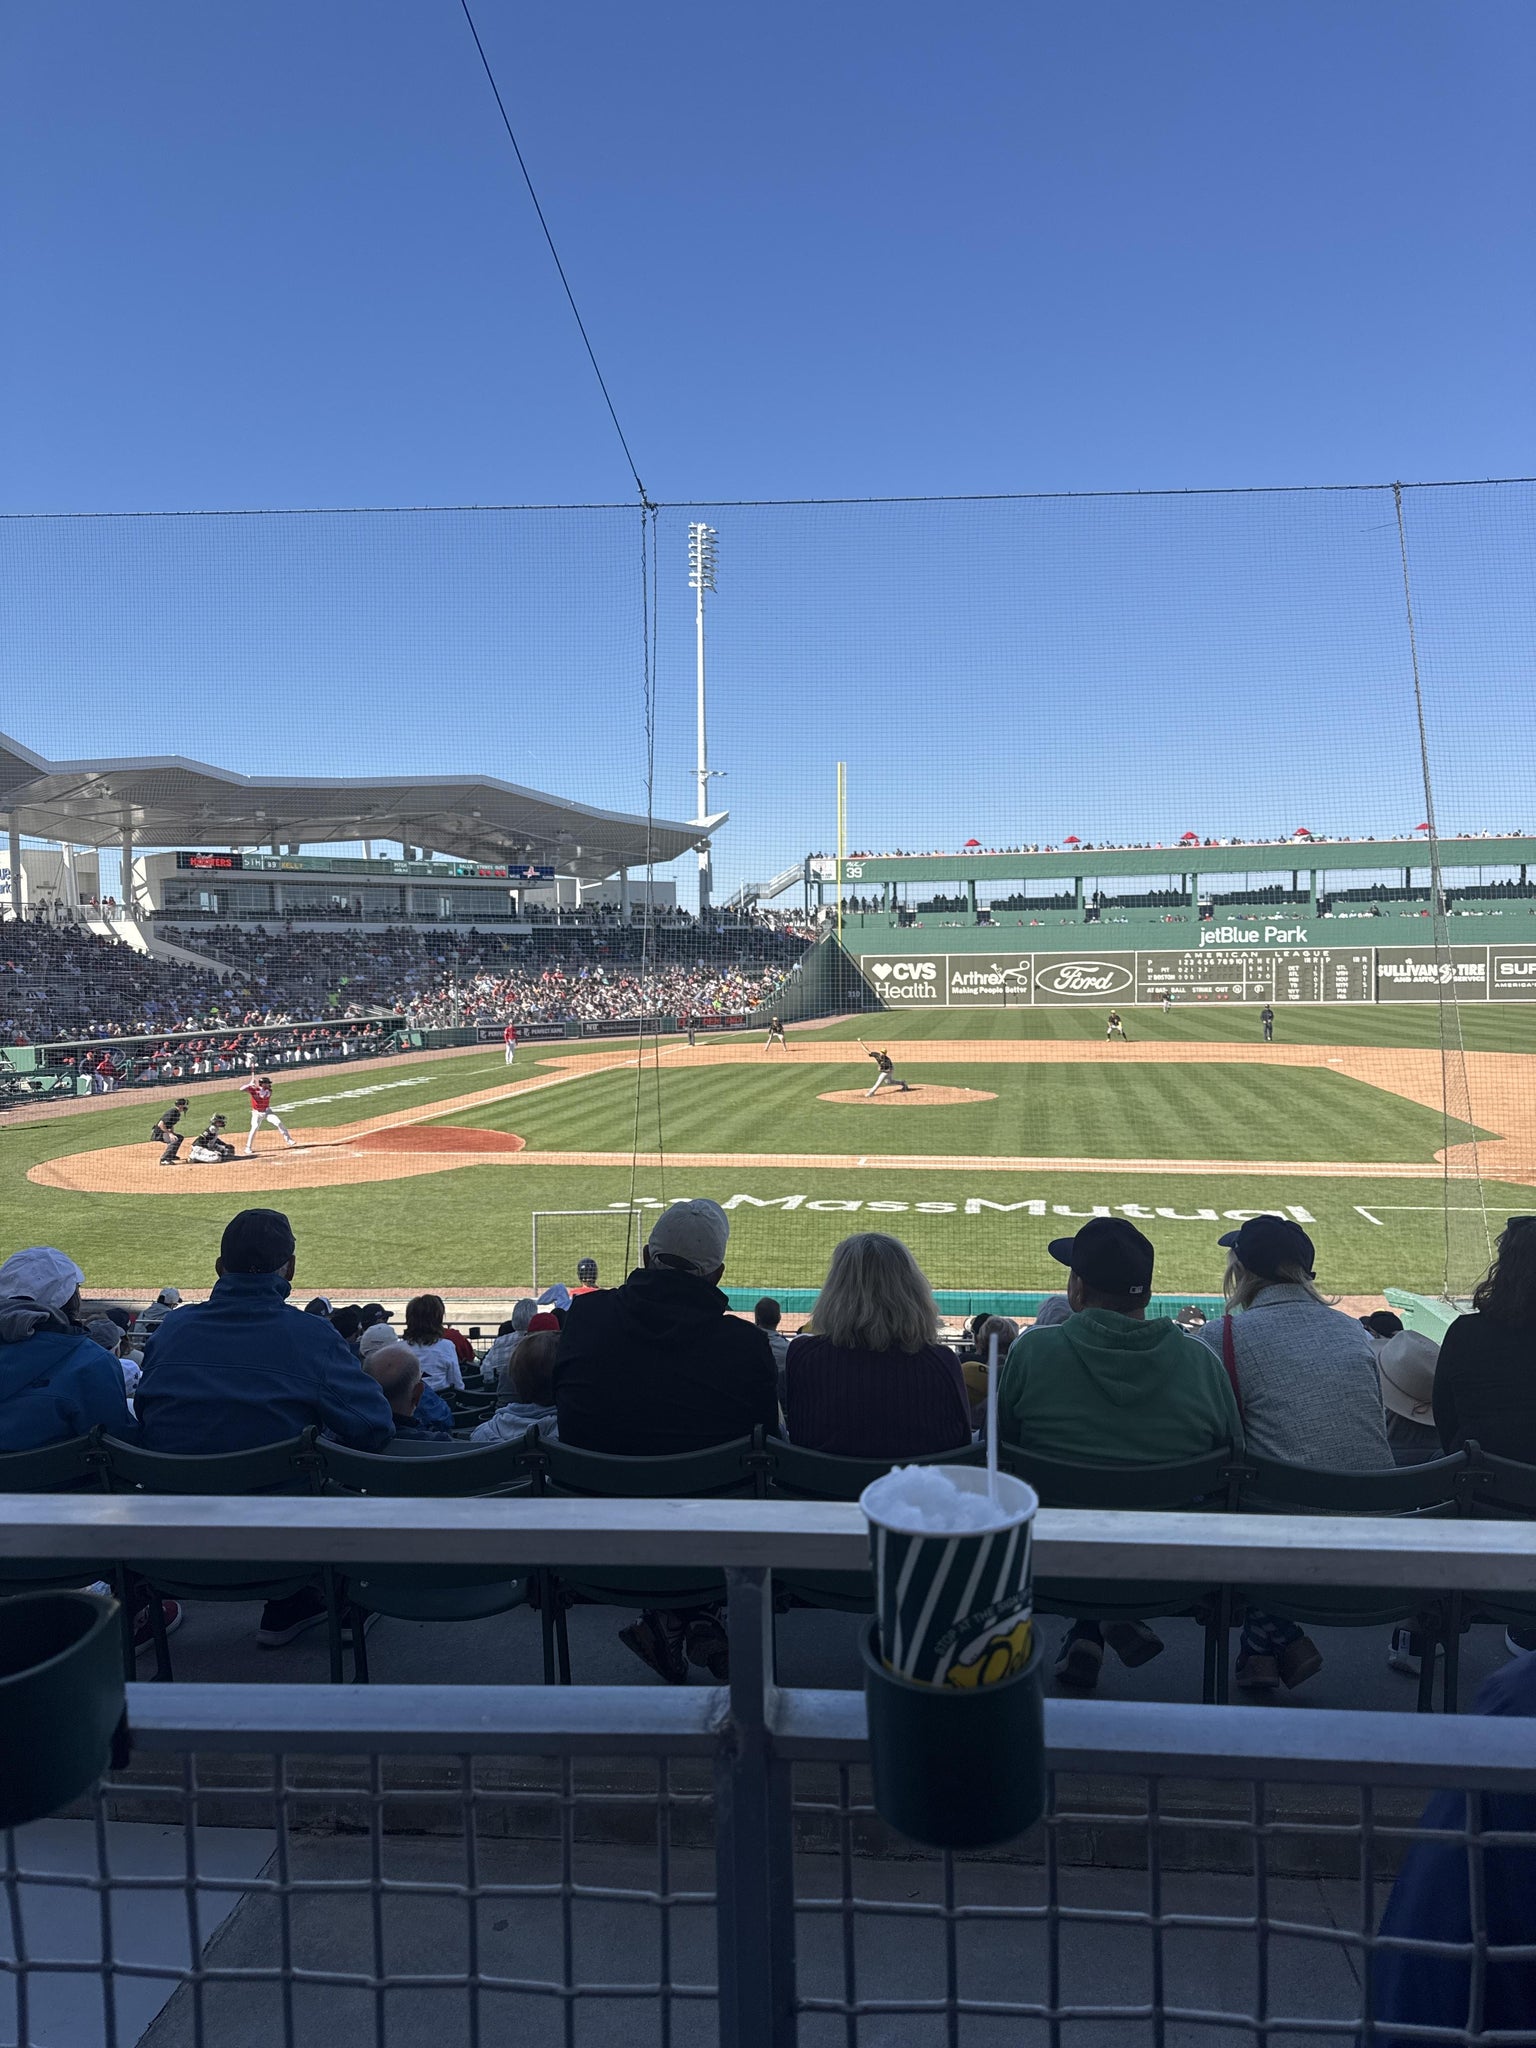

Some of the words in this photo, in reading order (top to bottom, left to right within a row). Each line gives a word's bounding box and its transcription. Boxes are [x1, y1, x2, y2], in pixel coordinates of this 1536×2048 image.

[846, 867, 862, 879] 39
[1198, 926, 1260, 948] jetBlue
[1264, 925, 1308, 943] Park
[892, 962, 937, 981] CVS
[951, 970, 1008, 986] Arthrex
[1053, 965, 1115, 990] Ford
[1377, 963, 1439, 977] SULLIVAN
[1456, 963, 1486, 976] TIRE
[875, 982, 937, 999] Health
[951, 987, 978, 995] Making
[979, 986, 1003, 995] People
[724, 1193, 1317, 1223] MassMutual
[934, 1629, 957, 1657] STOP
[972, 1606, 996, 1622] THE
